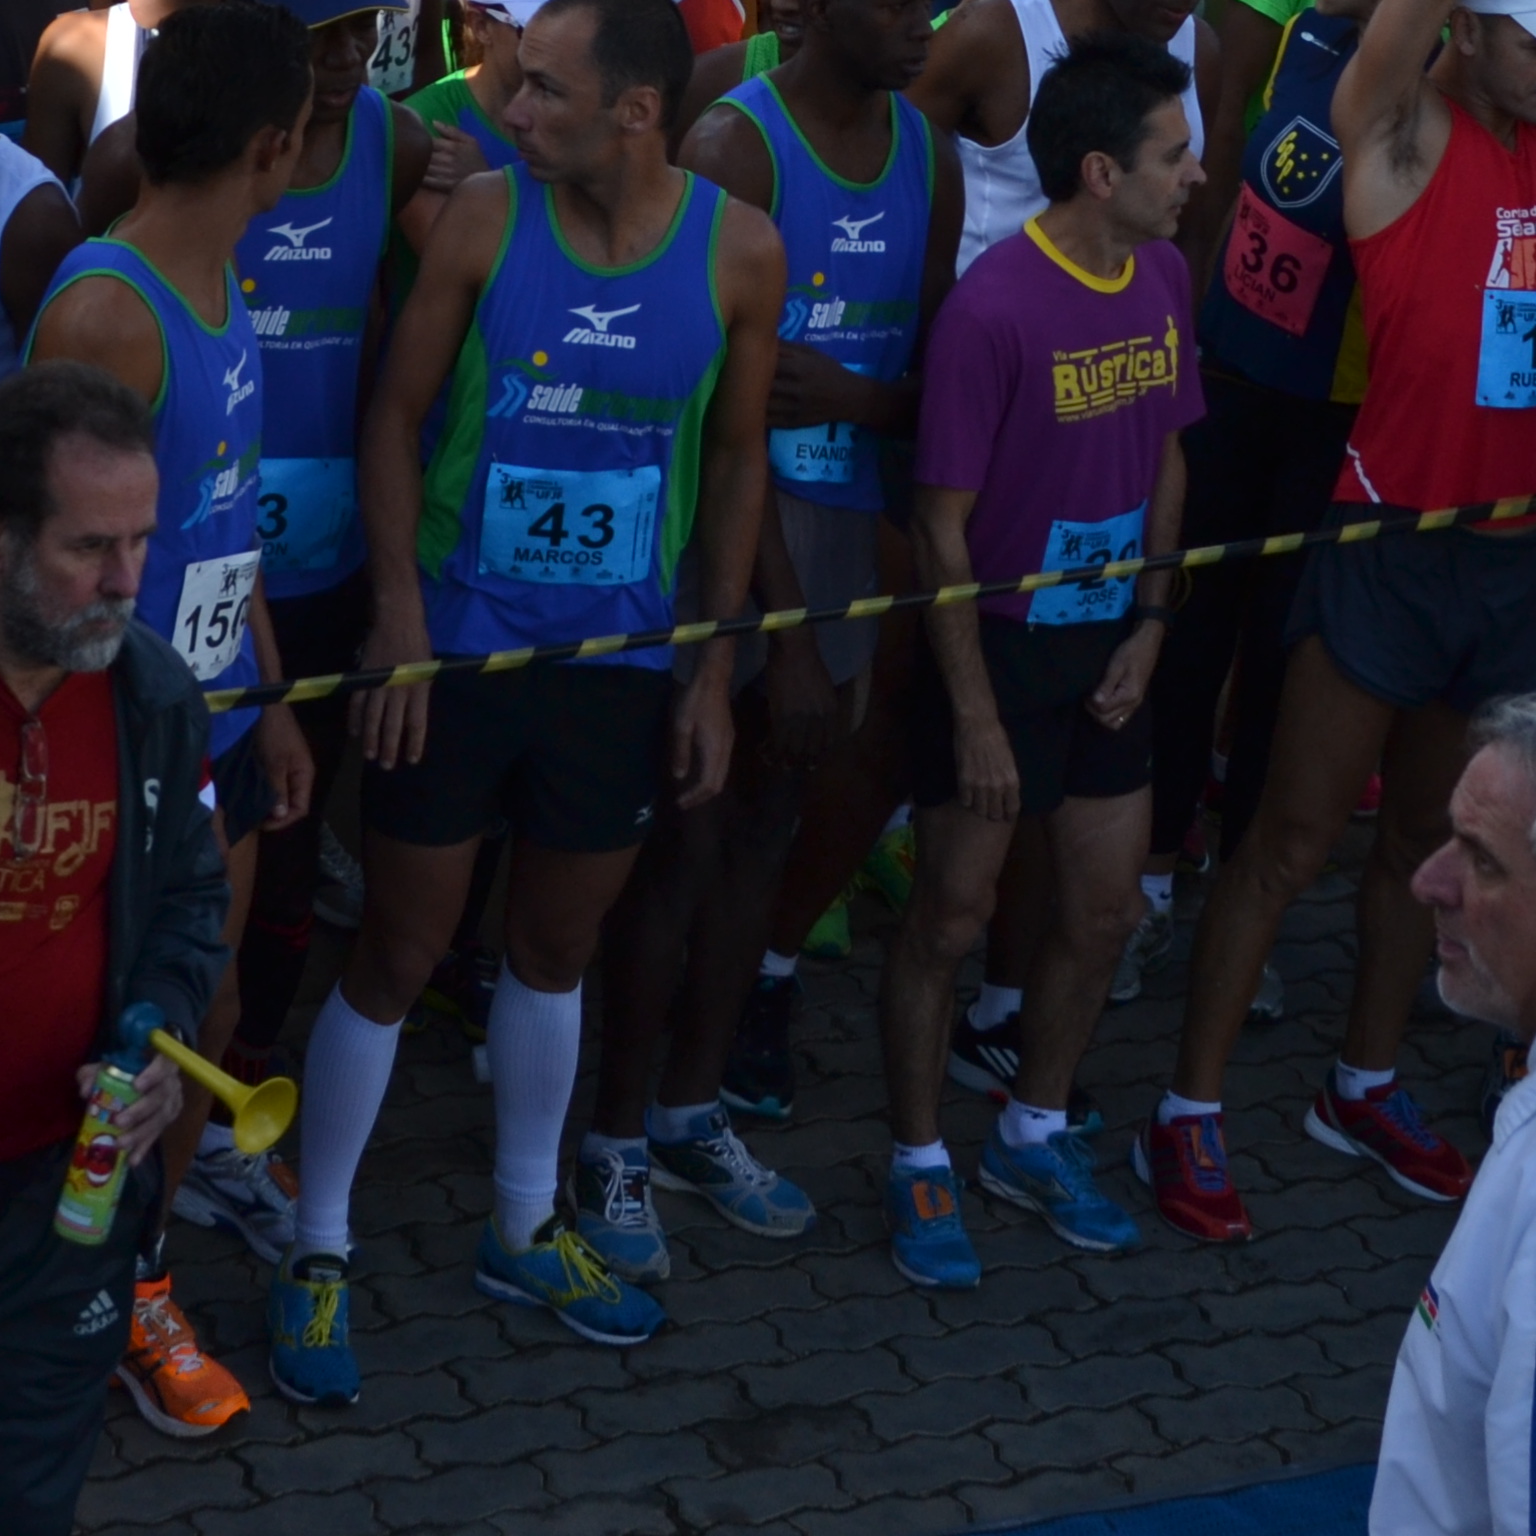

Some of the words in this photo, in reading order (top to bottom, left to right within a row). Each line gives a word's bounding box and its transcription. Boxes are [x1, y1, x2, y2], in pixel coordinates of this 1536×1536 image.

[263, 246, 332, 261] Mizuno
[1239, 232, 1303, 294] 36
[562, 328, 636, 350] Mizuno
[527, 502, 616, 549] 43
[513, 546, 604, 566] MARCOS
[1077, 584, 1119, 607] JOSÉ
